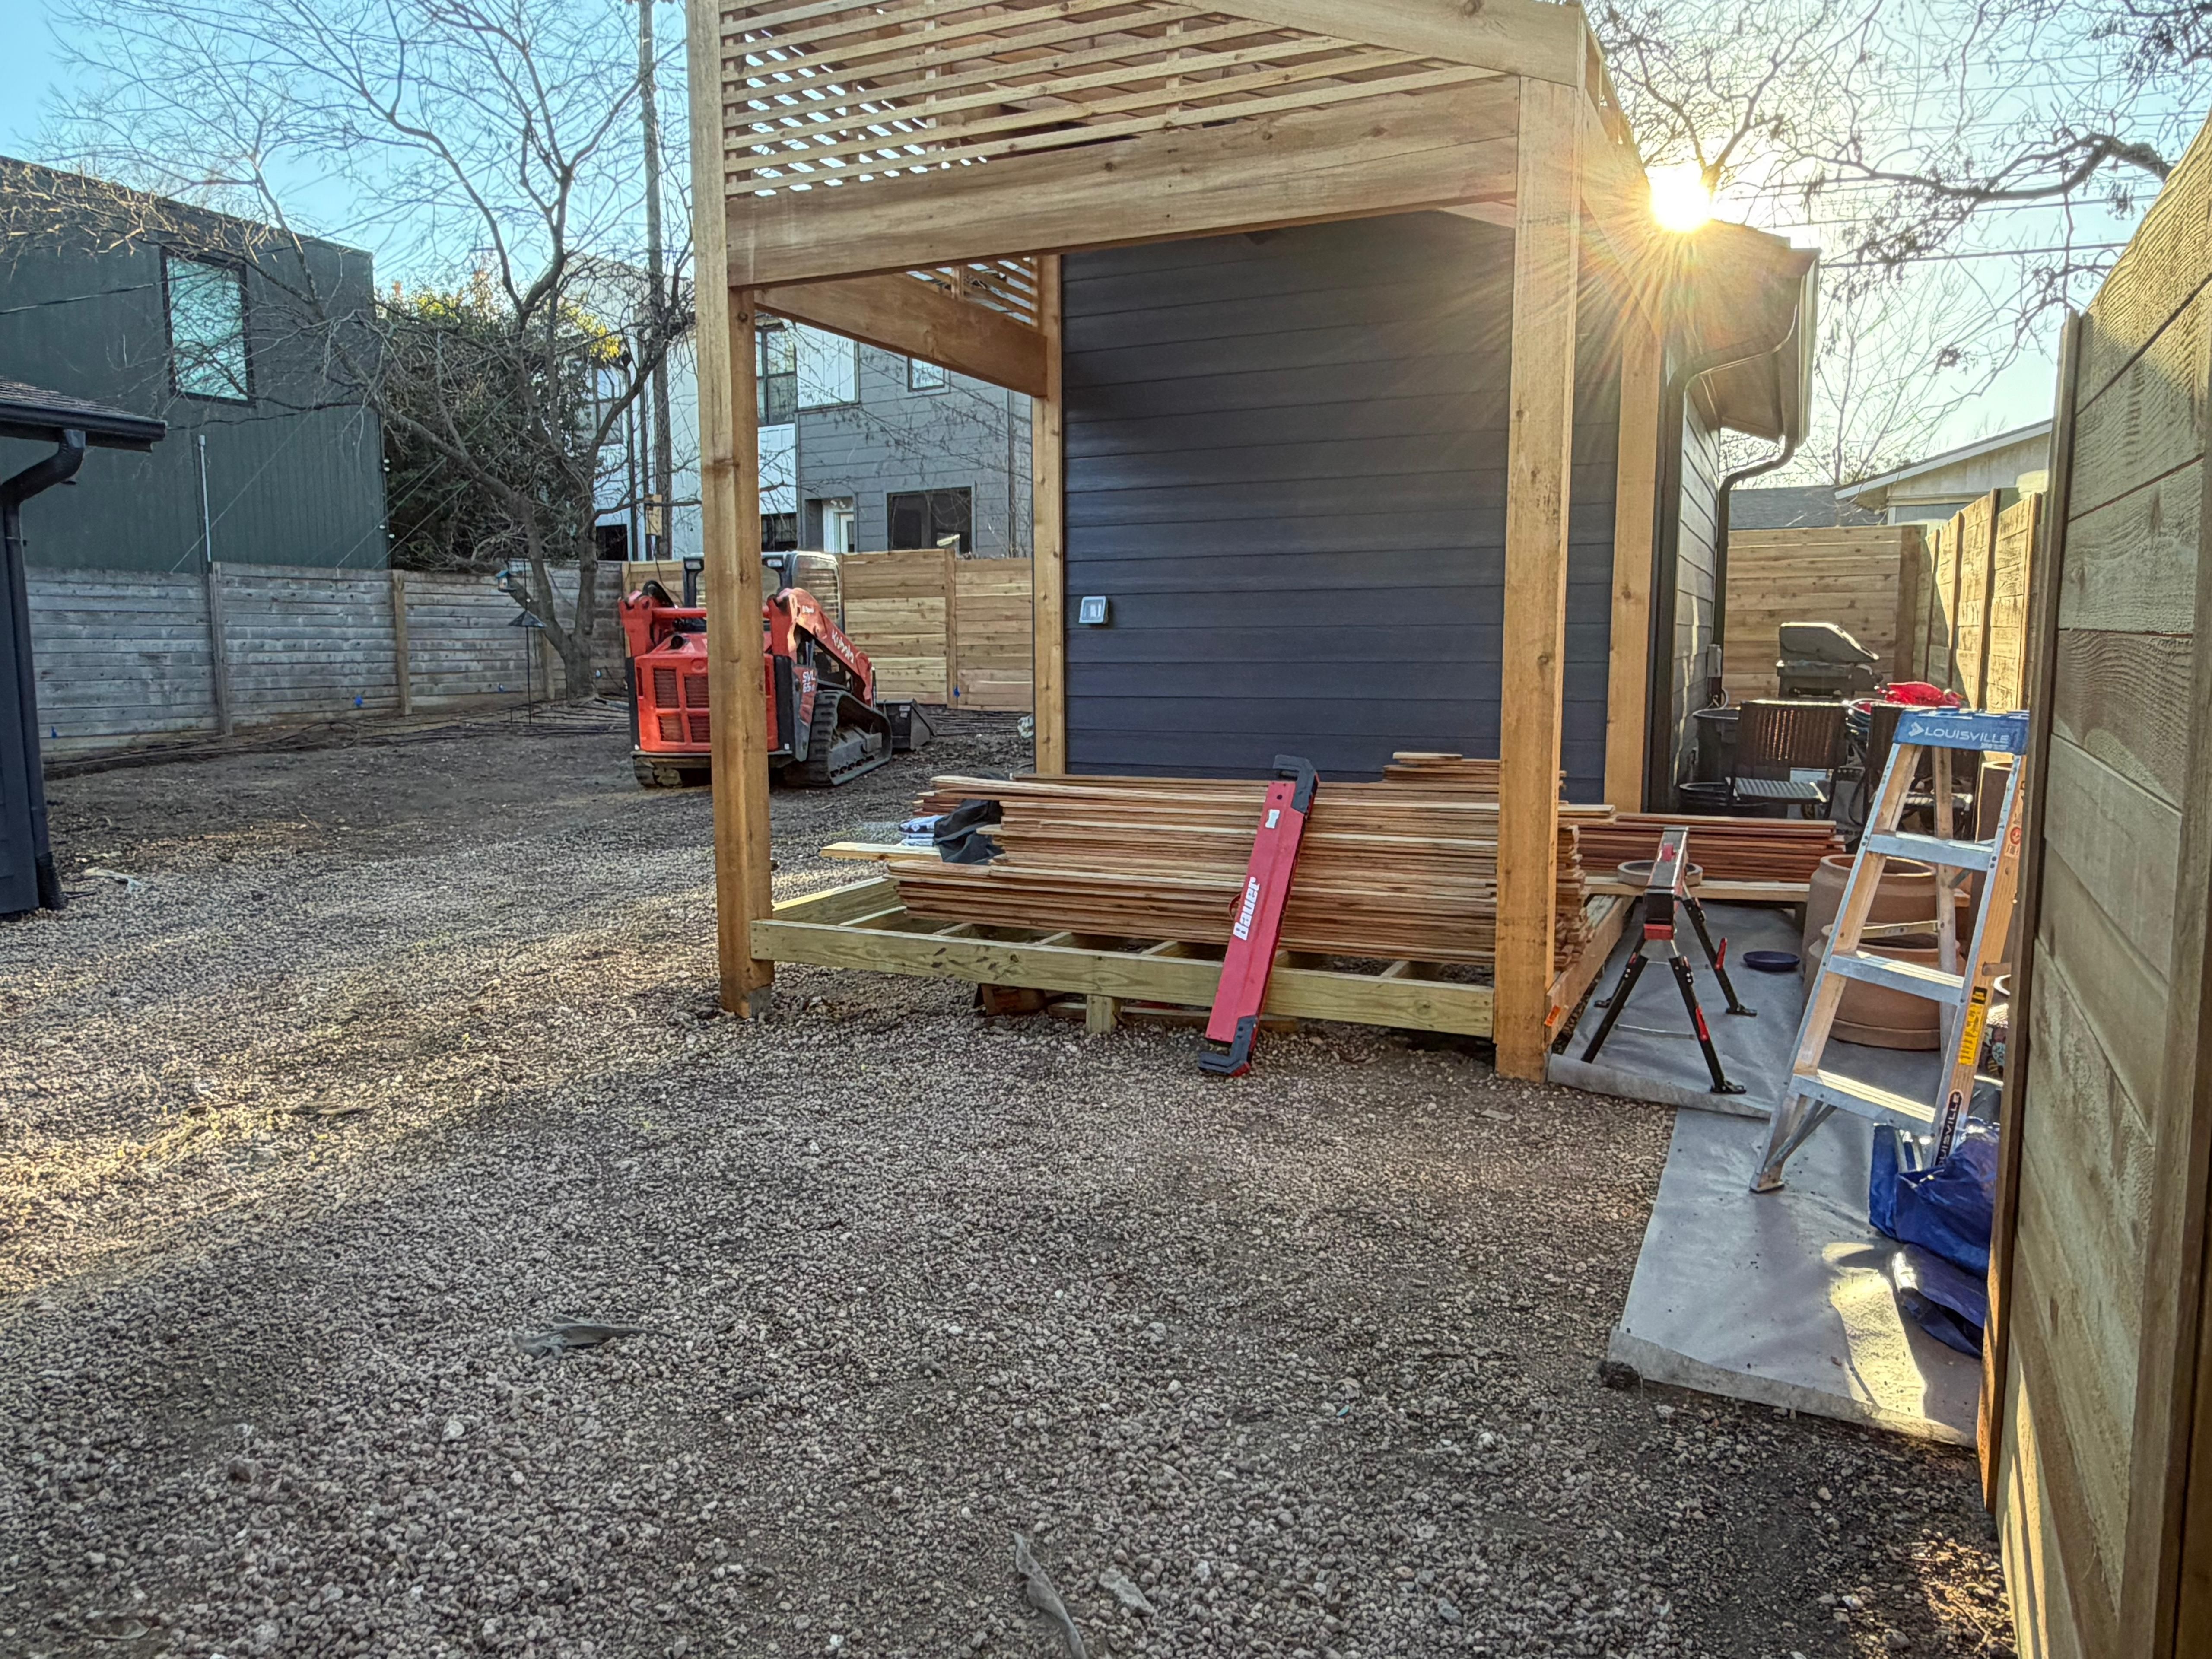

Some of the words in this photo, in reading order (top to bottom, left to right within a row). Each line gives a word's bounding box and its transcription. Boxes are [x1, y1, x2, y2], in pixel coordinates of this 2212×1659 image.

[1925, 727, 2009, 743] LOUISVILLE
[1233, 876, 1260, 941] Bauer
[1938, 1093, 1960, 1166] OUISVILLE
